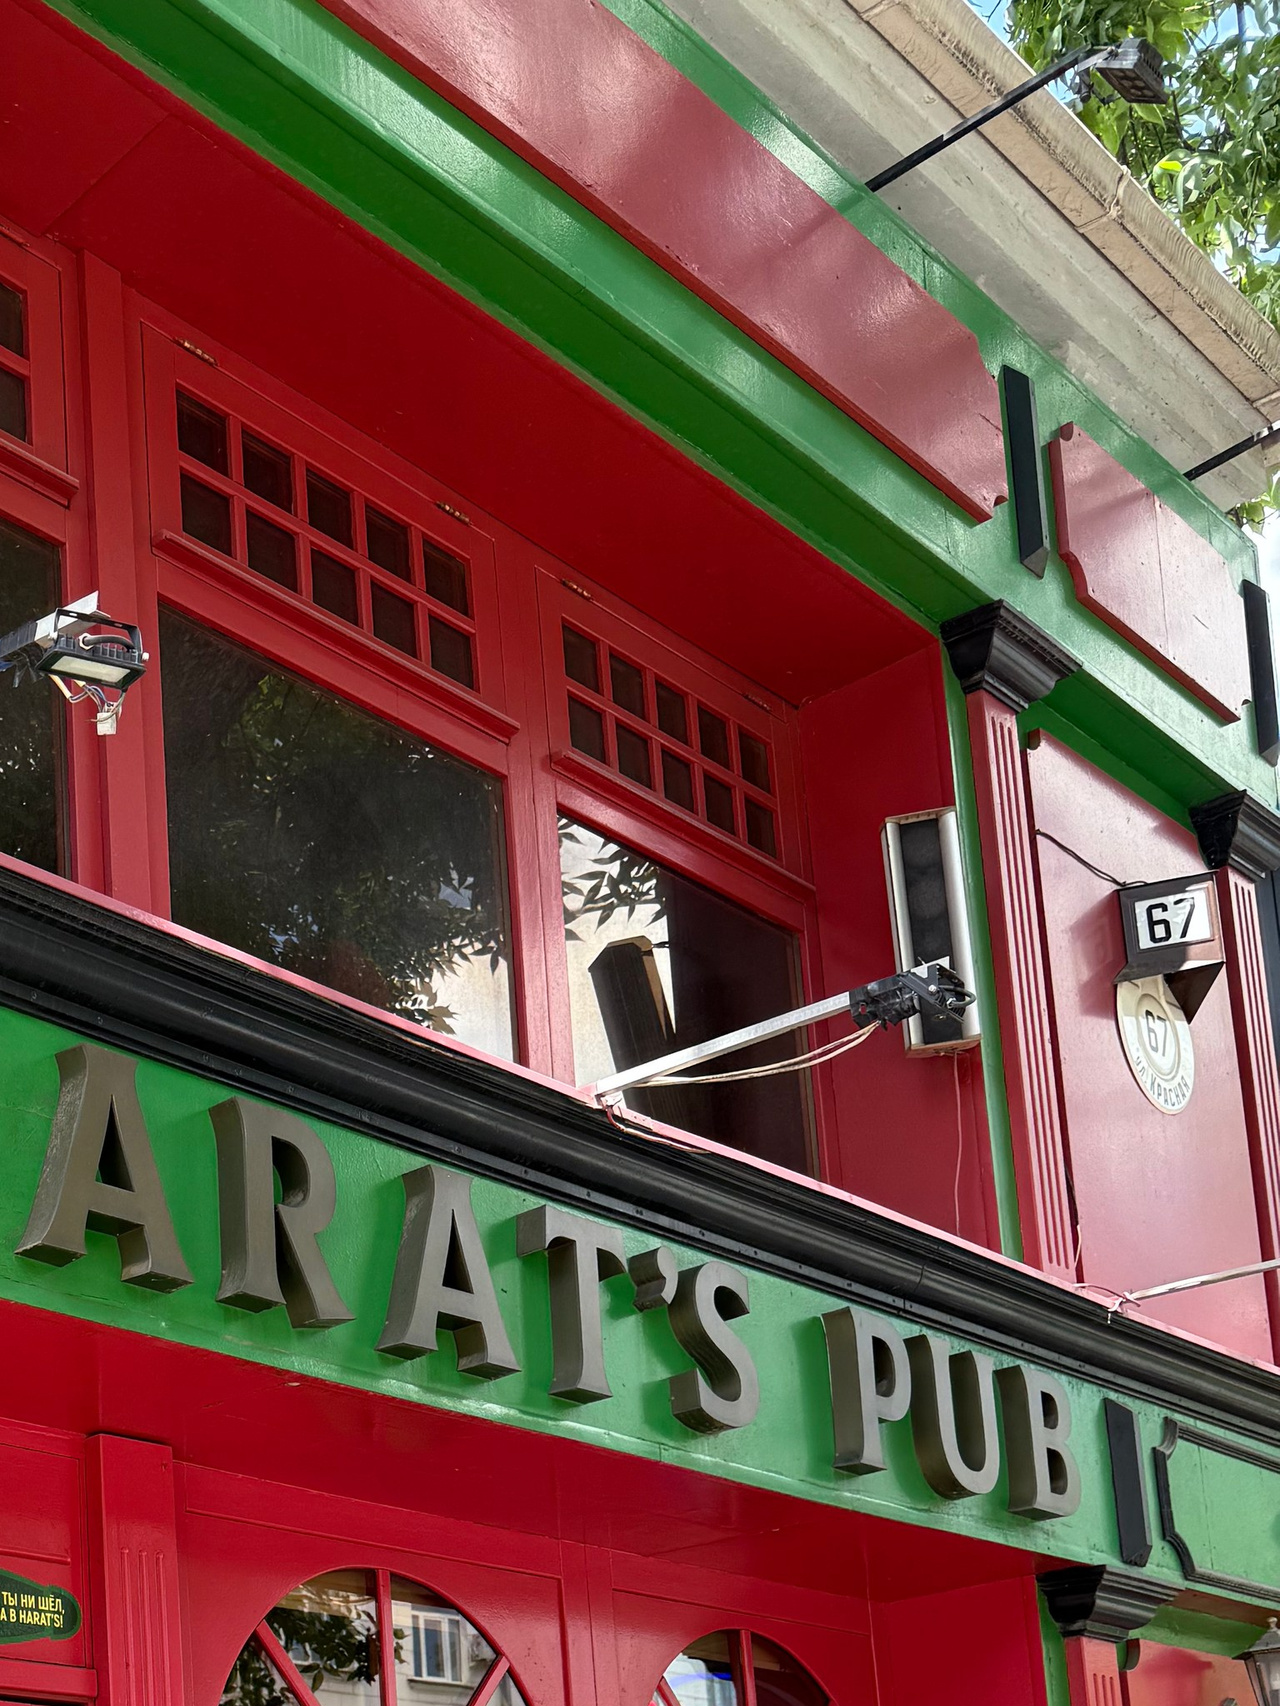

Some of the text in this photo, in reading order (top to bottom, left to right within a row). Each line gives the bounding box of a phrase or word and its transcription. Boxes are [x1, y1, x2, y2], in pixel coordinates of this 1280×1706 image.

[1145, 897, 1196, 944] 67
[1145, 1009, 1168, 1058] 67
[1150, 1075, 1191, 1108] КРАСНАЯ
[822, 1306, 1081, 1521] PUB
[1, 1591, 18, 1606] ТЫ
[20, 1594, 36, 1608] НИ
[38, 1594, 65, 1614] ШЁЛ,
[9, 1608, 17, 1622] В
[19, 1610, 64, 1628] HARAT'S!
